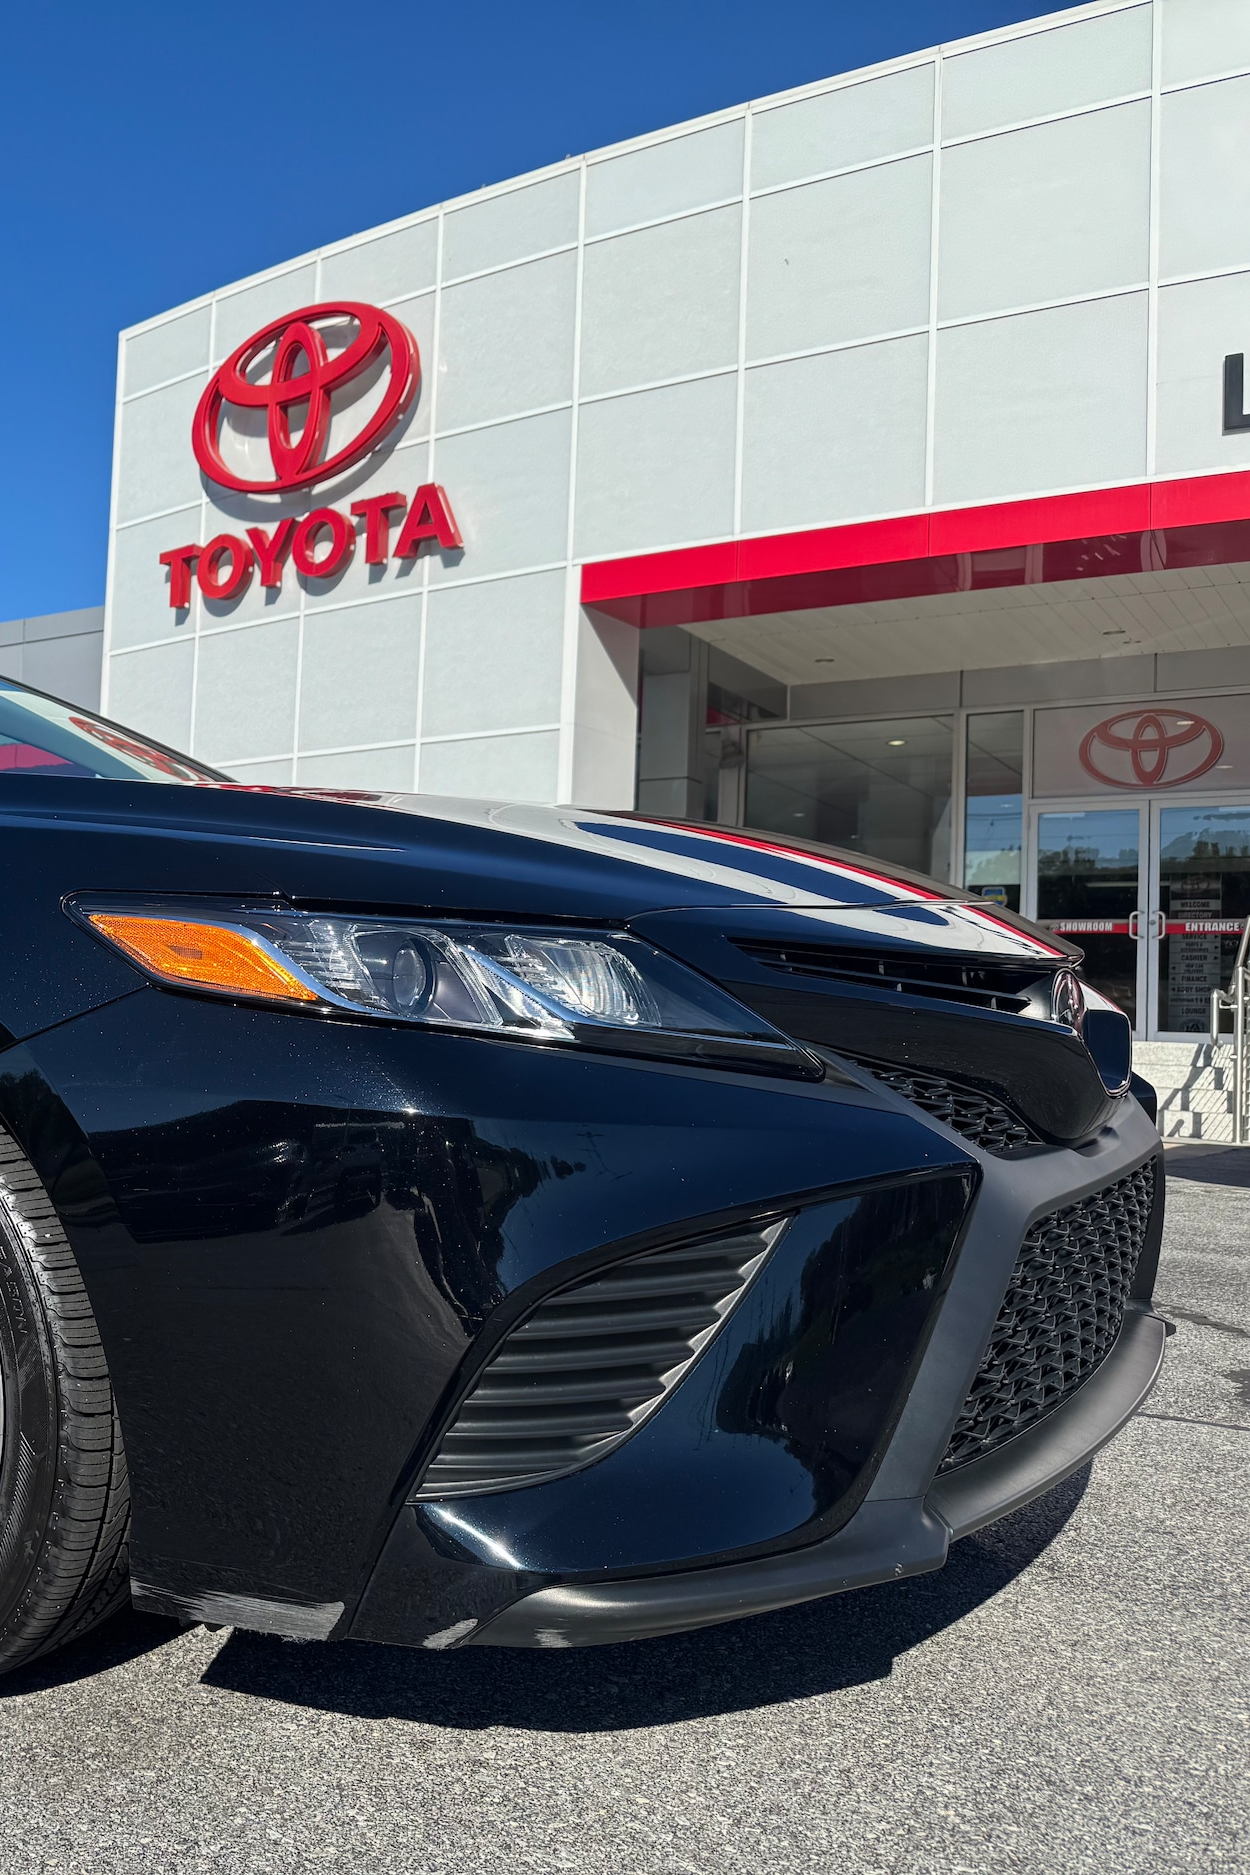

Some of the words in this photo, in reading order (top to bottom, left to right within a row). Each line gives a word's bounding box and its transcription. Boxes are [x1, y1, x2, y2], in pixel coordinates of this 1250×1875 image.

[159, 482, 464, 609] TOYOTA
[1060, 922, 1113, 932] SHOWROOM
[1185, 922, 1240, 932] ENTRANCE
[1181, 1007, 1207, 1015] LOUNGE
